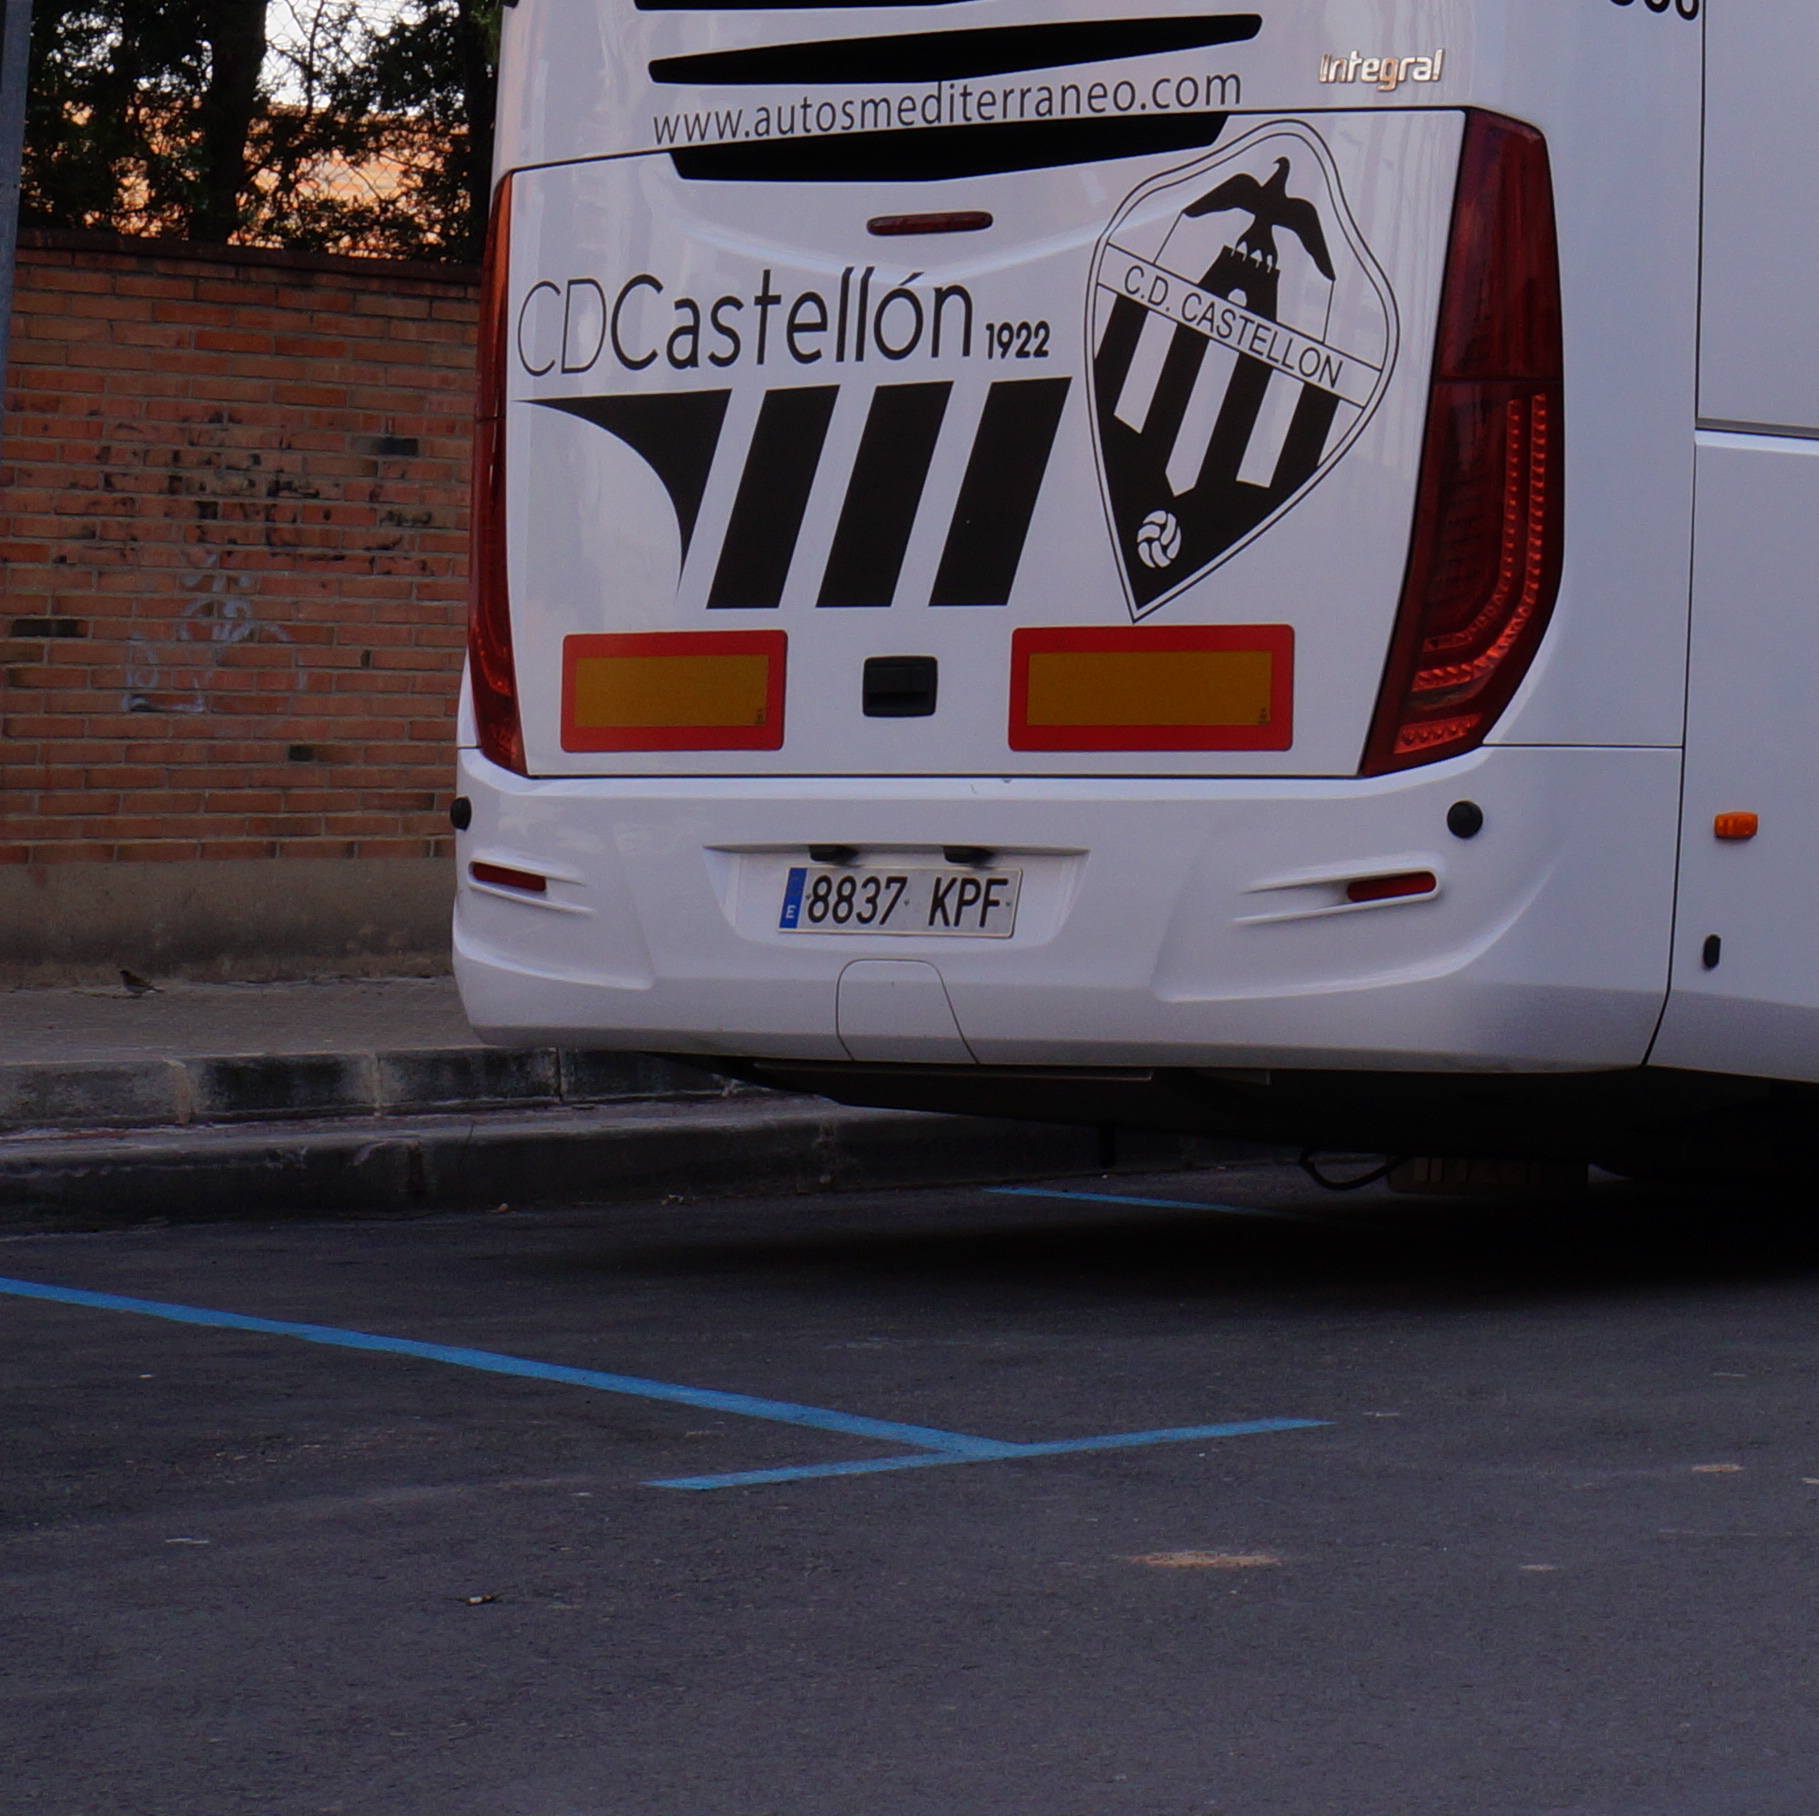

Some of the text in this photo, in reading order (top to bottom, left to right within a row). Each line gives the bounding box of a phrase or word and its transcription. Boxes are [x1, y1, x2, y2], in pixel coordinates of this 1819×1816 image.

[1319, 47, 1444, 92] Integral
[653, 66, 1242, 146] www.autosmediterraneo.com
[985, 319, 1051, 360] 1922
[1124, 265, 1344, 389] C.D. CASTELLON
[807, 874, 1010, 928] 8837 KPF
